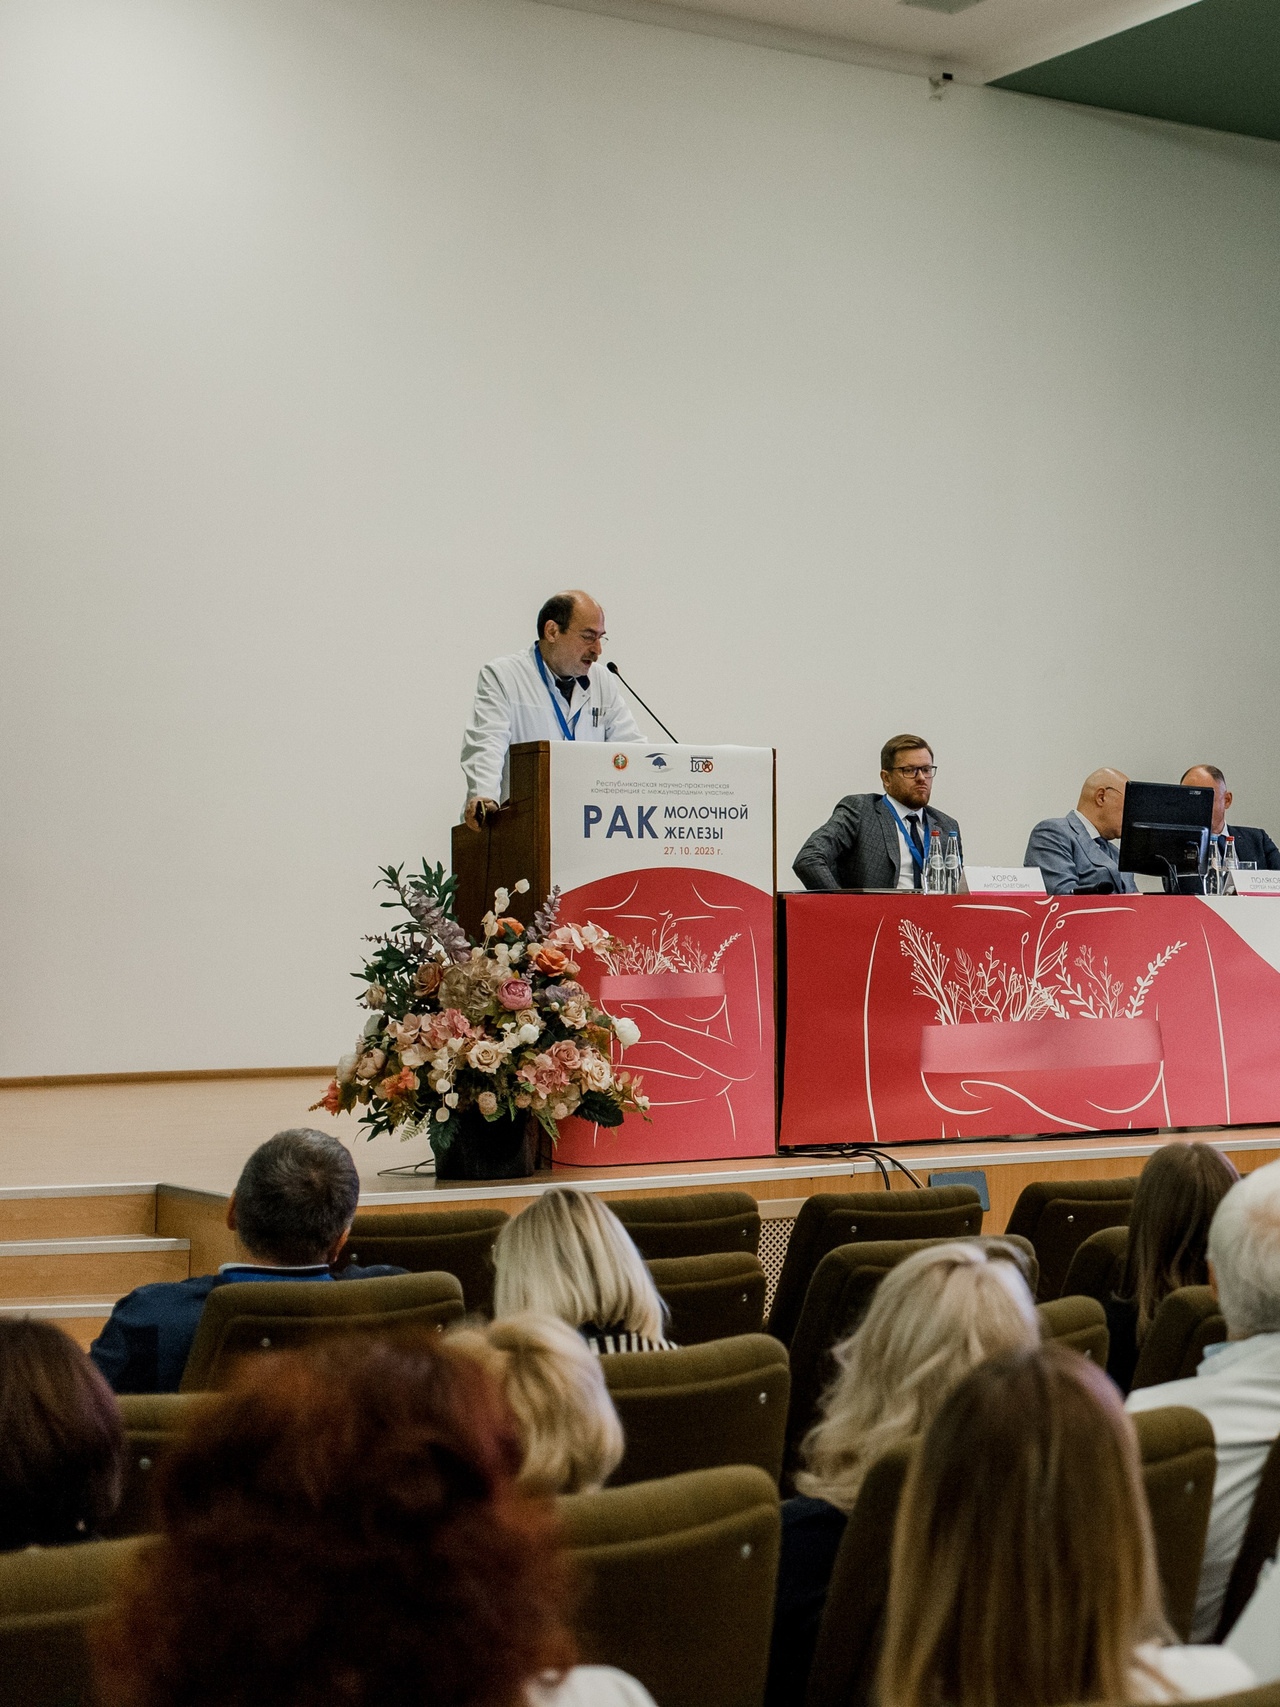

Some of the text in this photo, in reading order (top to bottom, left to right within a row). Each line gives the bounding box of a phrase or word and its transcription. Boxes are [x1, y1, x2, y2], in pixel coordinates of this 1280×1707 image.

[596, 780, 657, 789] Республиканская
[591, 787, 640, 795] конференция
[664, 804, 748, 819] МОЛОЧНОЙ
[583, 805, 659, 839] РАК
[664, 827, 723, 840] ЖЕЛЕЗЫ
[664, 847, 723, 856] 27. 10. 2023 г.
[992, 874, 1018, 882] ХОРОВ
